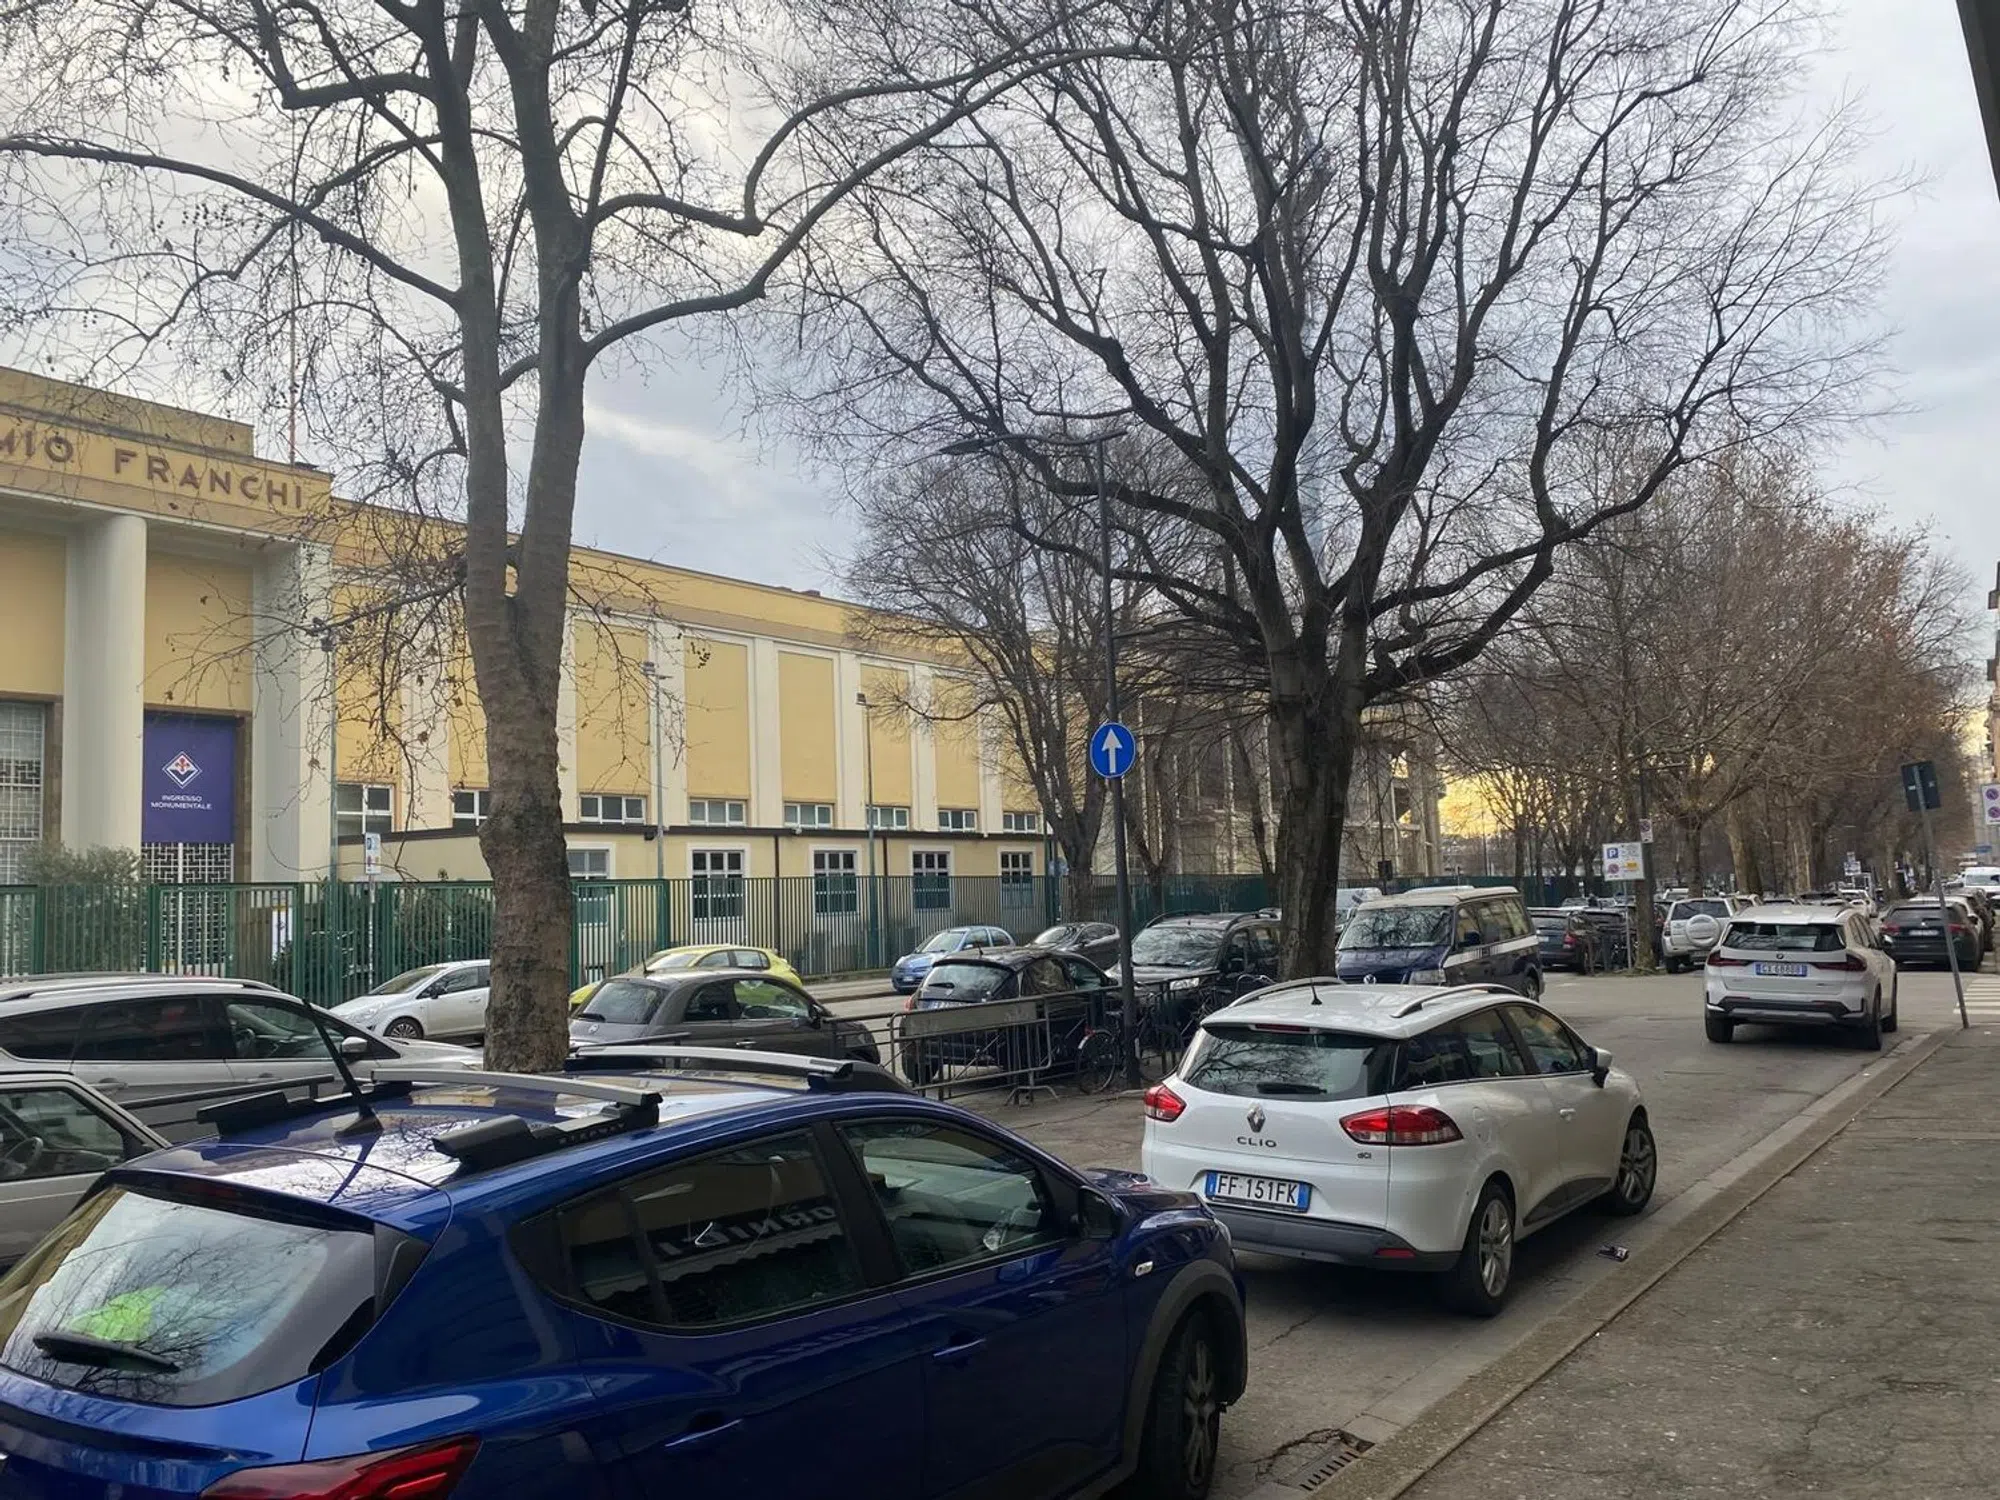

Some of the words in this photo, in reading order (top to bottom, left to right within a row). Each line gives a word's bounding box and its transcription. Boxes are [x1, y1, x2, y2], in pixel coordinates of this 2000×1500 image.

[115, 448, 302, 508] FRANCHI
[161, 794, 203, 802] INGRESSO
[150, 801, 213, 811] MONUMENTALE
[1237, 1136, 1277, 1148] CLIO
